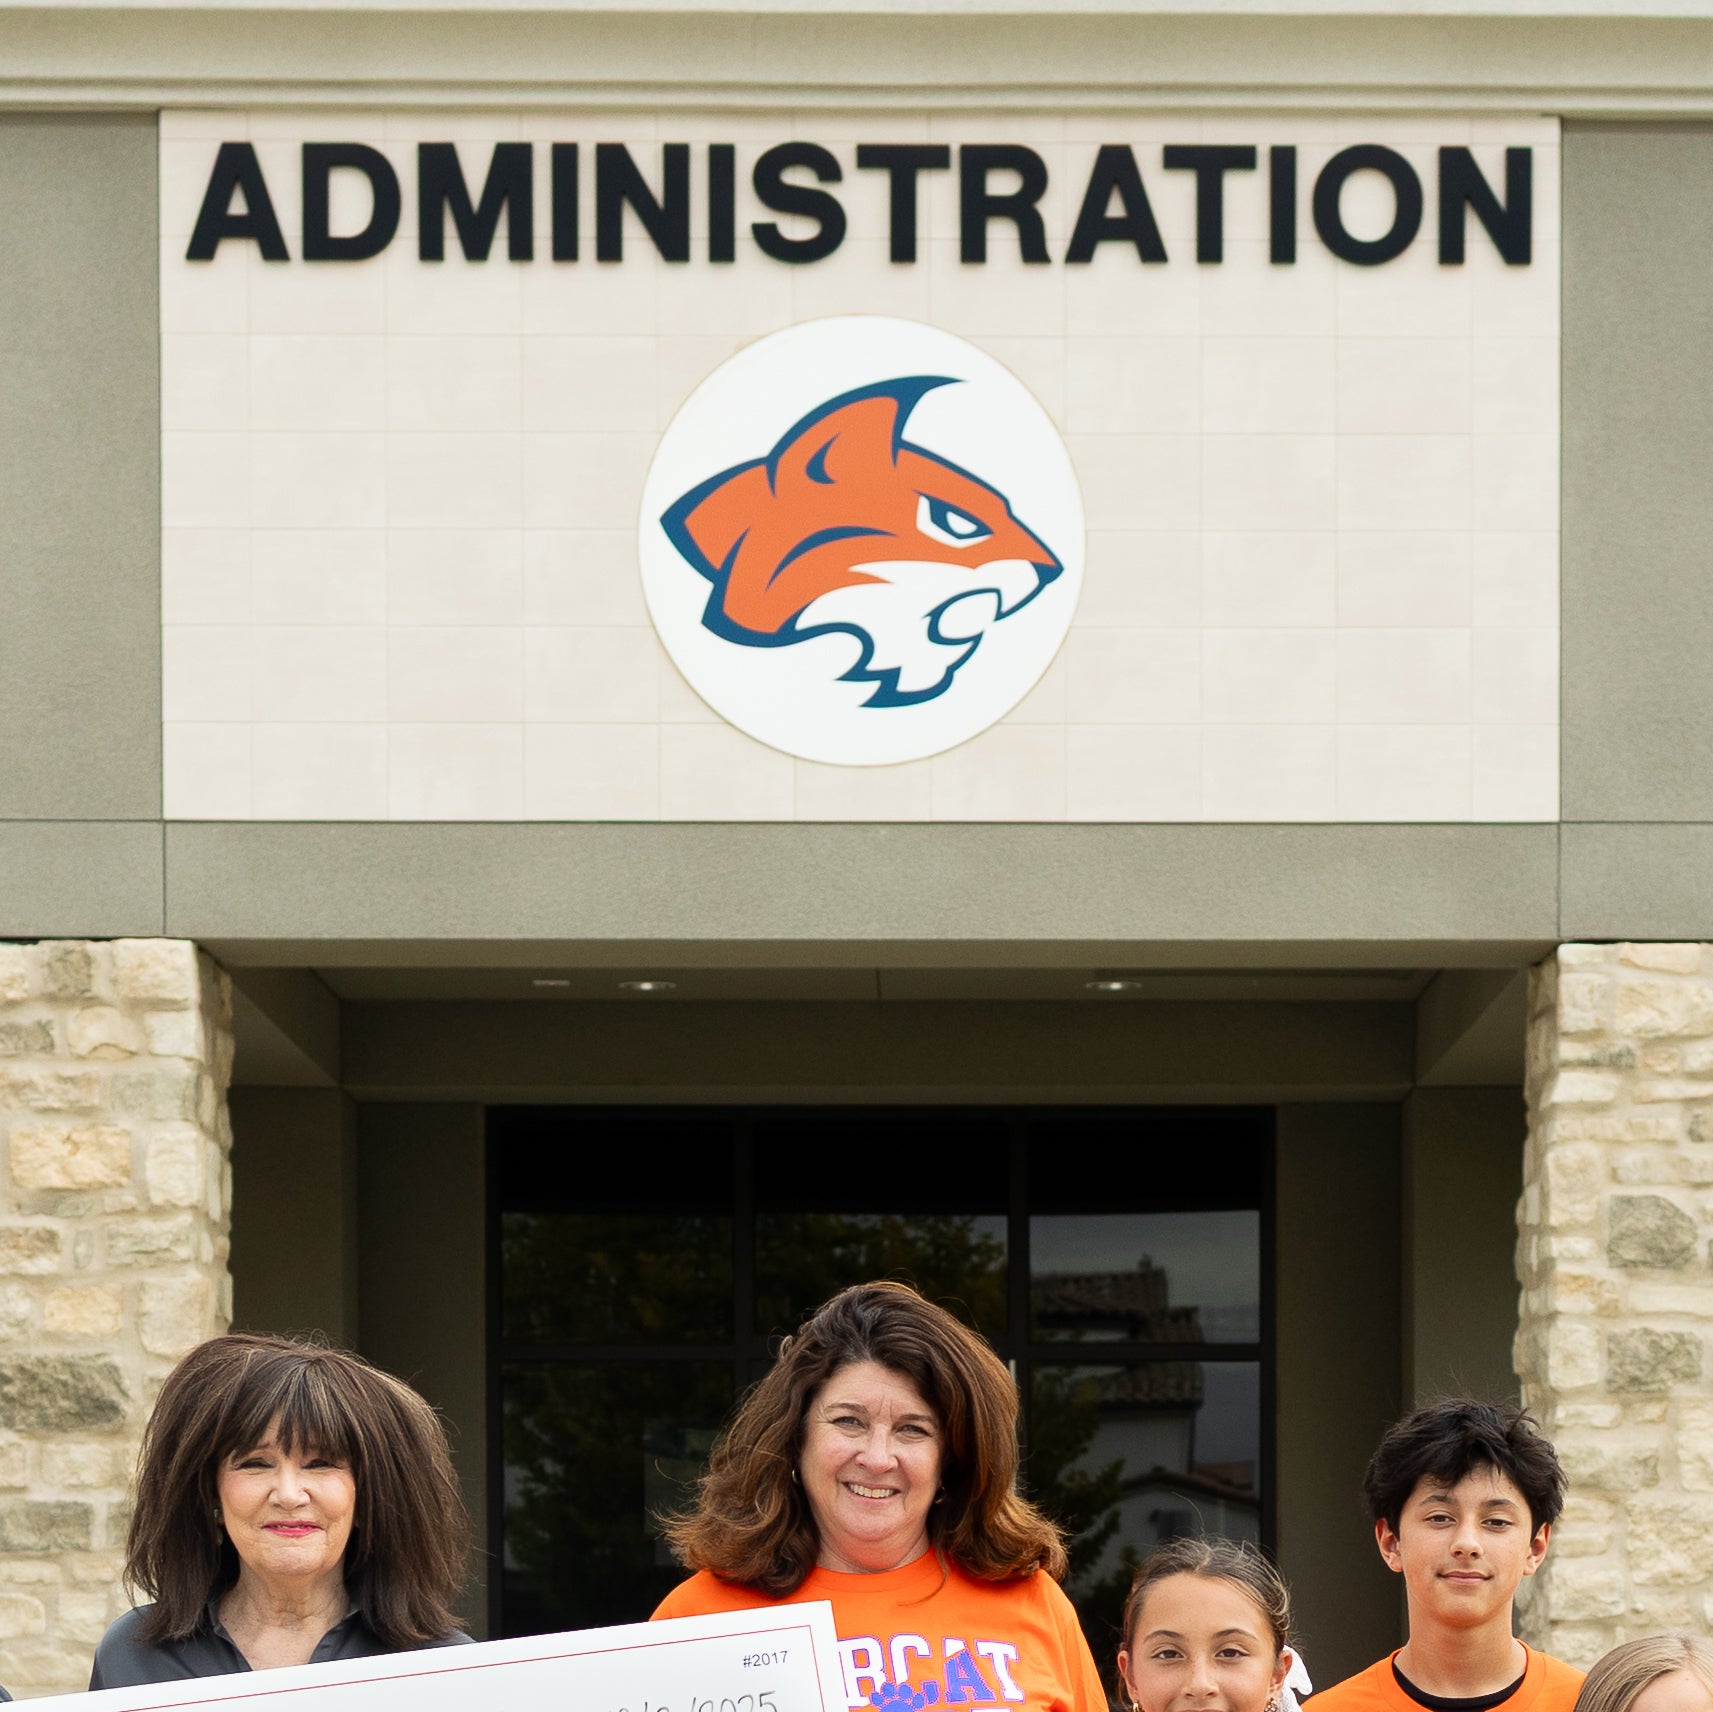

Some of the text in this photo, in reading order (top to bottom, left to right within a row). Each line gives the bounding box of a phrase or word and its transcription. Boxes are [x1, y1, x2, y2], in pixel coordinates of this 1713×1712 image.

[187, 143, 1531, 266] ADMINISTRATION
[742, 1650, 788, 1669] #2017
[837, 1632, 1025, 1709] BCAT
